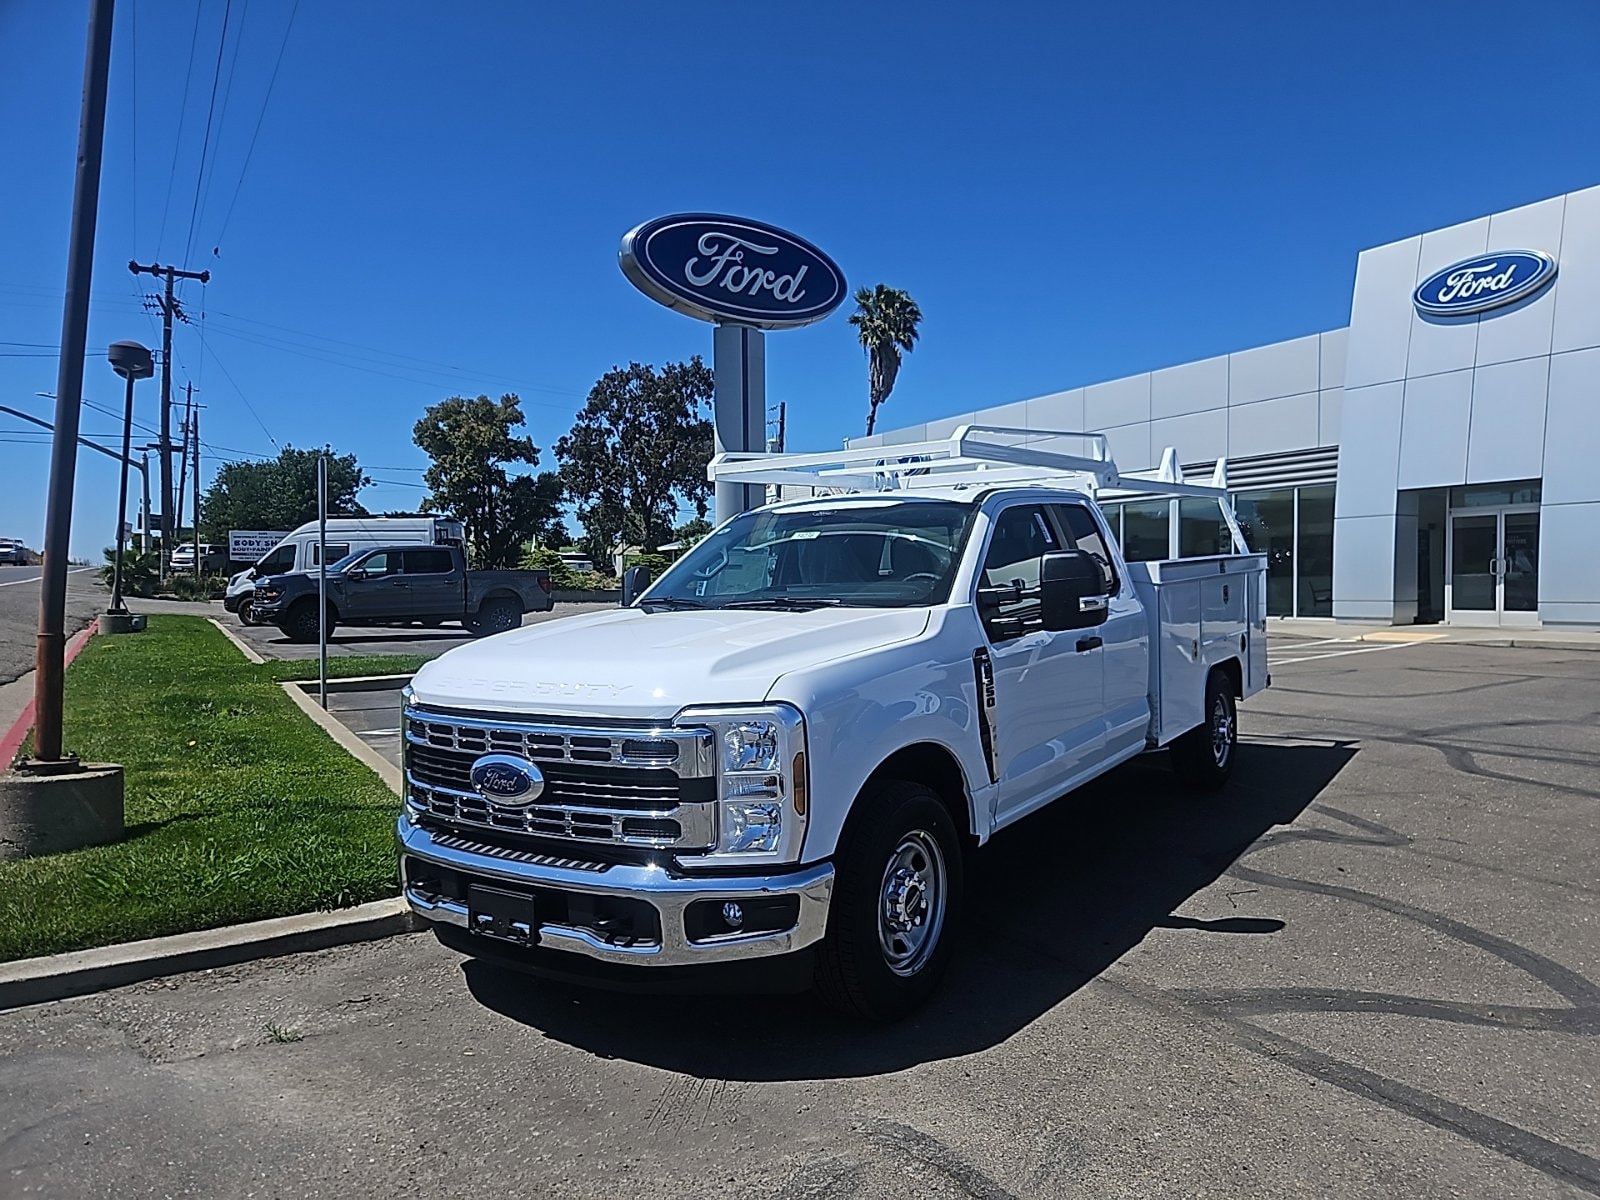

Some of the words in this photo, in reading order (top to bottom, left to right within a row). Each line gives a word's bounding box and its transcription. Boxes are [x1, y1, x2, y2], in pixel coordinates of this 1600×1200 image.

[685, 232, 808, 303] Ford
[1438, 262, 1517, 302] Ford
[483, 767, 518, 791] Ford
